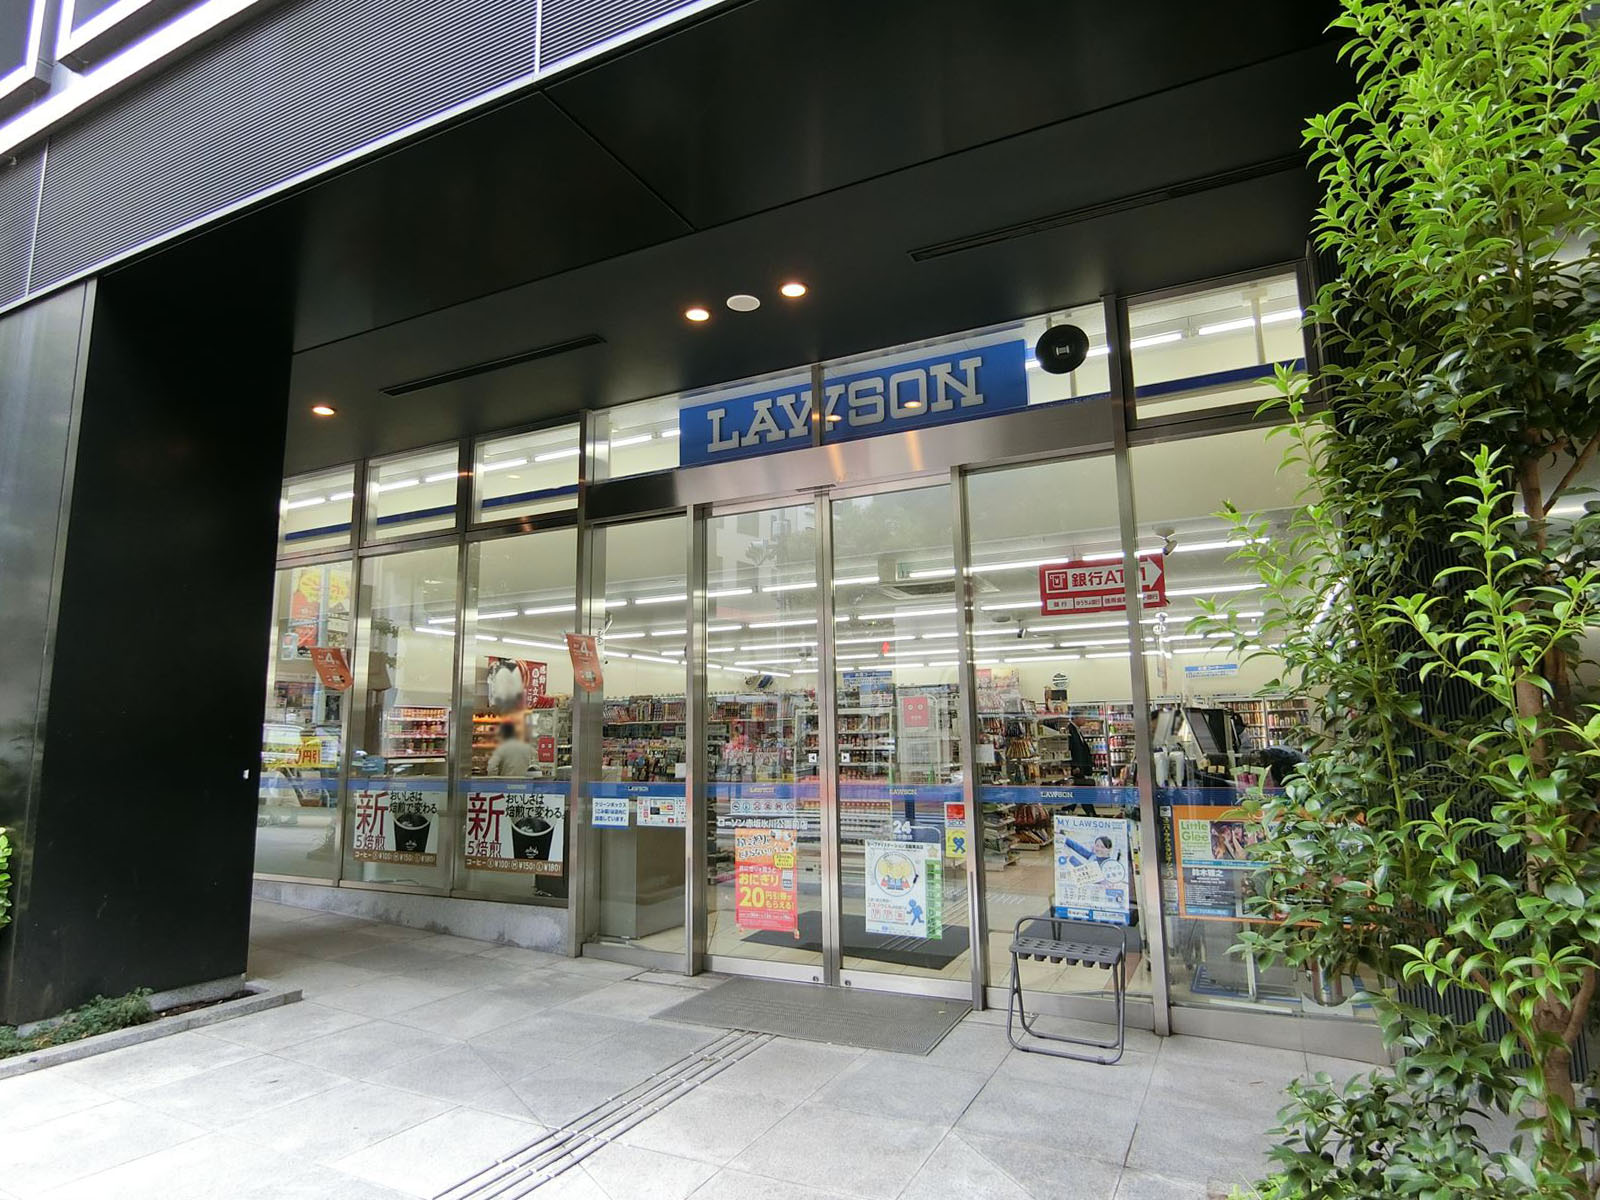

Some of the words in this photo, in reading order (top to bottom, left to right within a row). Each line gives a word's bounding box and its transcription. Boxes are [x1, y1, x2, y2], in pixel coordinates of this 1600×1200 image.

[707, 356, 984, 453] LAWSON
[1071, 567, 1146, 588] 銀行AT
[390, 791, 423, 801] おいしさは
[506, 794, 544, 804] おいしさは
[356, 789, 389, 835] 新
[467, 793, 504, 840] 新
[892, 820, 912, 834] 24
[1057, 818, 1070, 826] MY
[1073, 819, 1111, 829] LAWSON
[1181, 821, 1208, 831] Little
[1181, 831, 1209, 841] Glee
[467, 840, 502, 857] 5焙煎
[738, 873, 779, 886] おにぎり
[739, 886, 765, 907] 20
